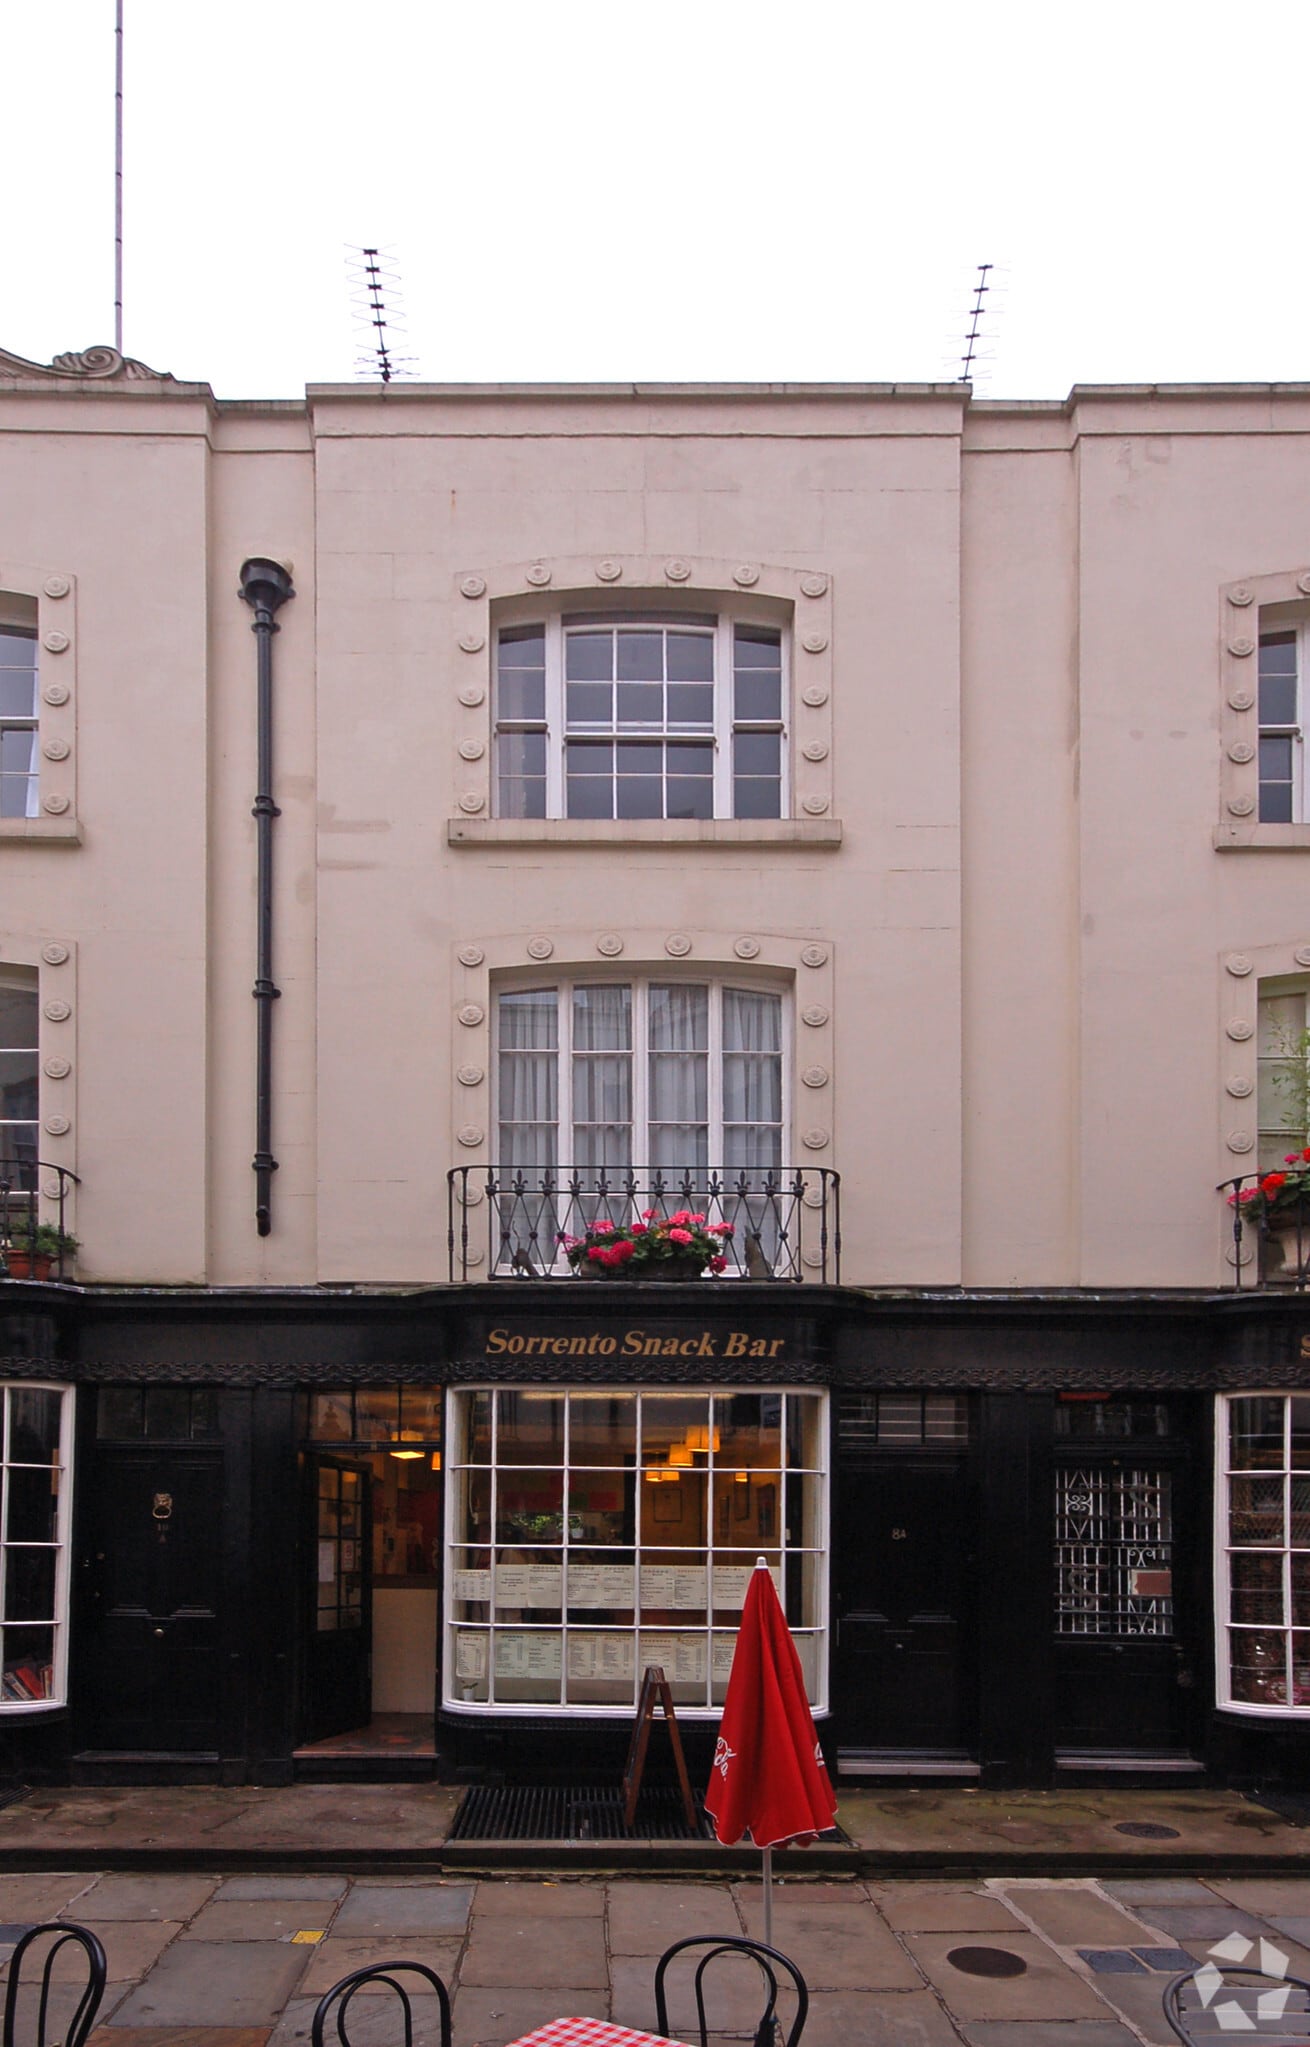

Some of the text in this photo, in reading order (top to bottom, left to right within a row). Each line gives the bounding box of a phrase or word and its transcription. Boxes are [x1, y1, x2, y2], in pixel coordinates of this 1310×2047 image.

[486, 1328, 785, 1358] Sorrento Snack Bar
